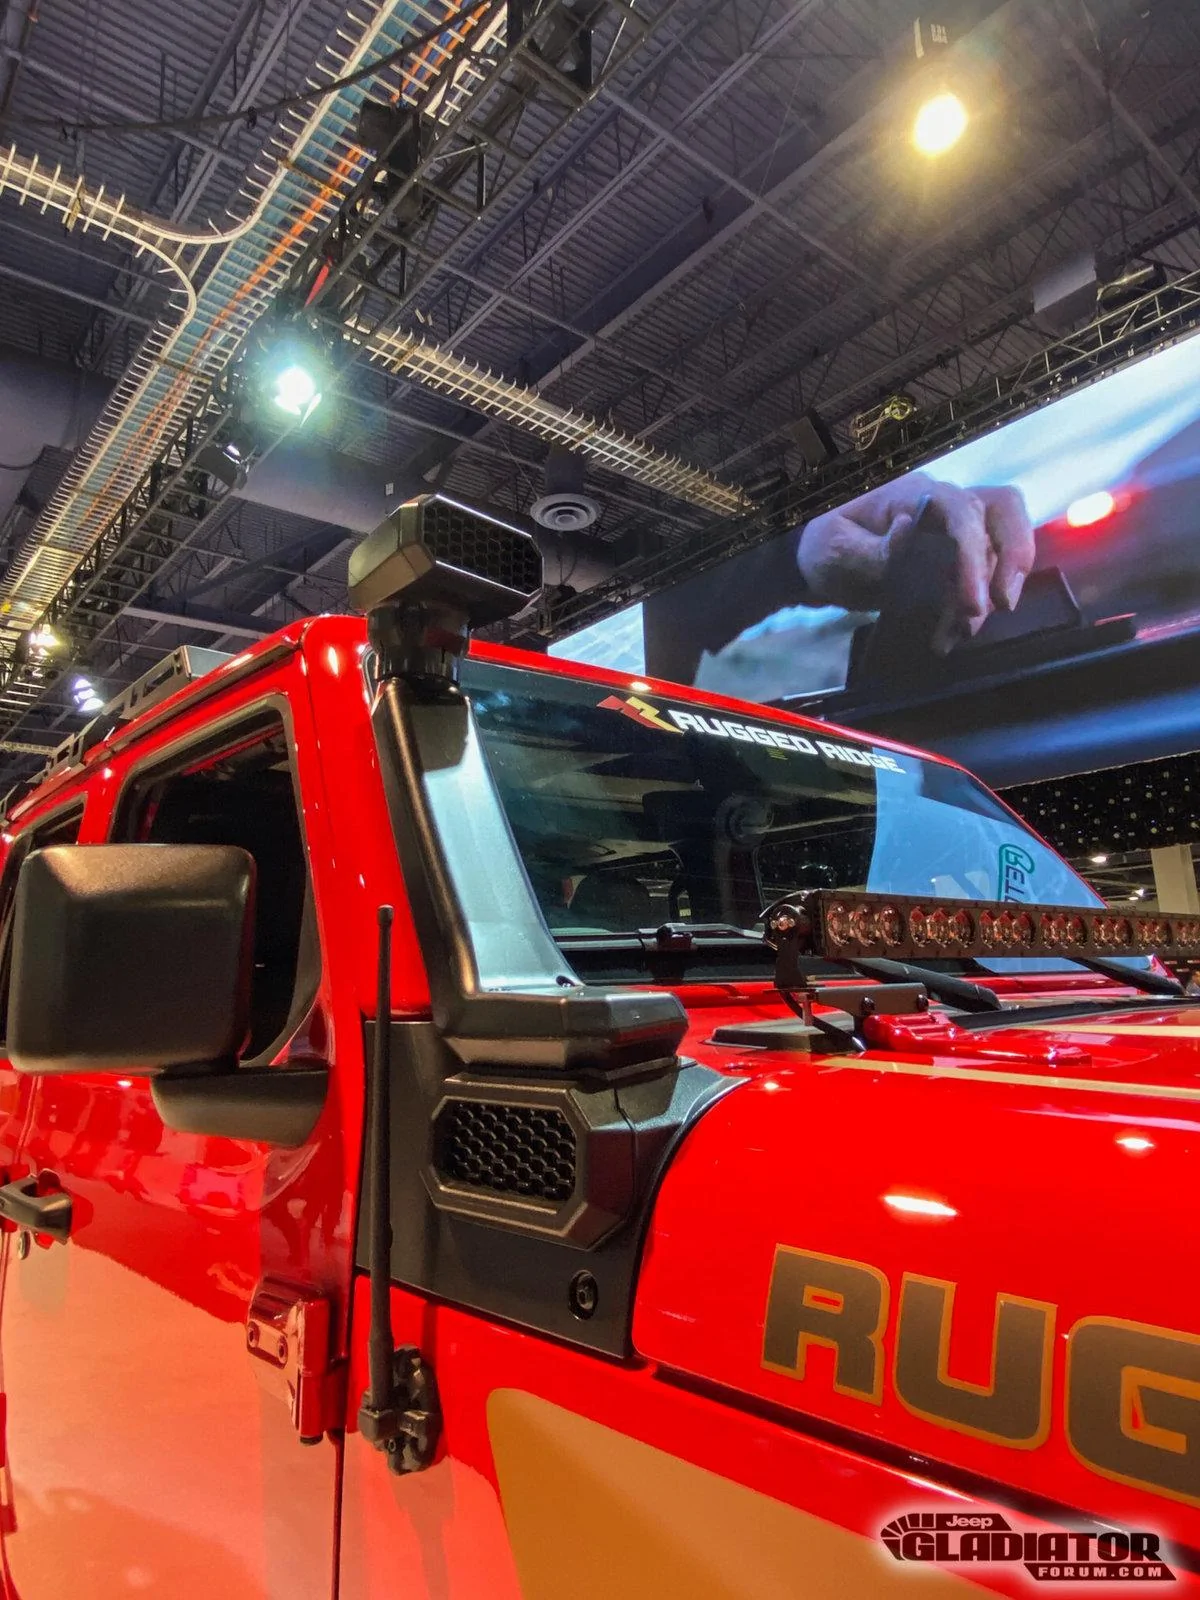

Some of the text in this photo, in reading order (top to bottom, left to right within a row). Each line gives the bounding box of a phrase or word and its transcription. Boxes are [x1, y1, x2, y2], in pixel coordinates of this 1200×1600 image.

[667, 709, 906, 774] RUGGED RIDGE
[760, 1243, 1200, 1508] RUG
